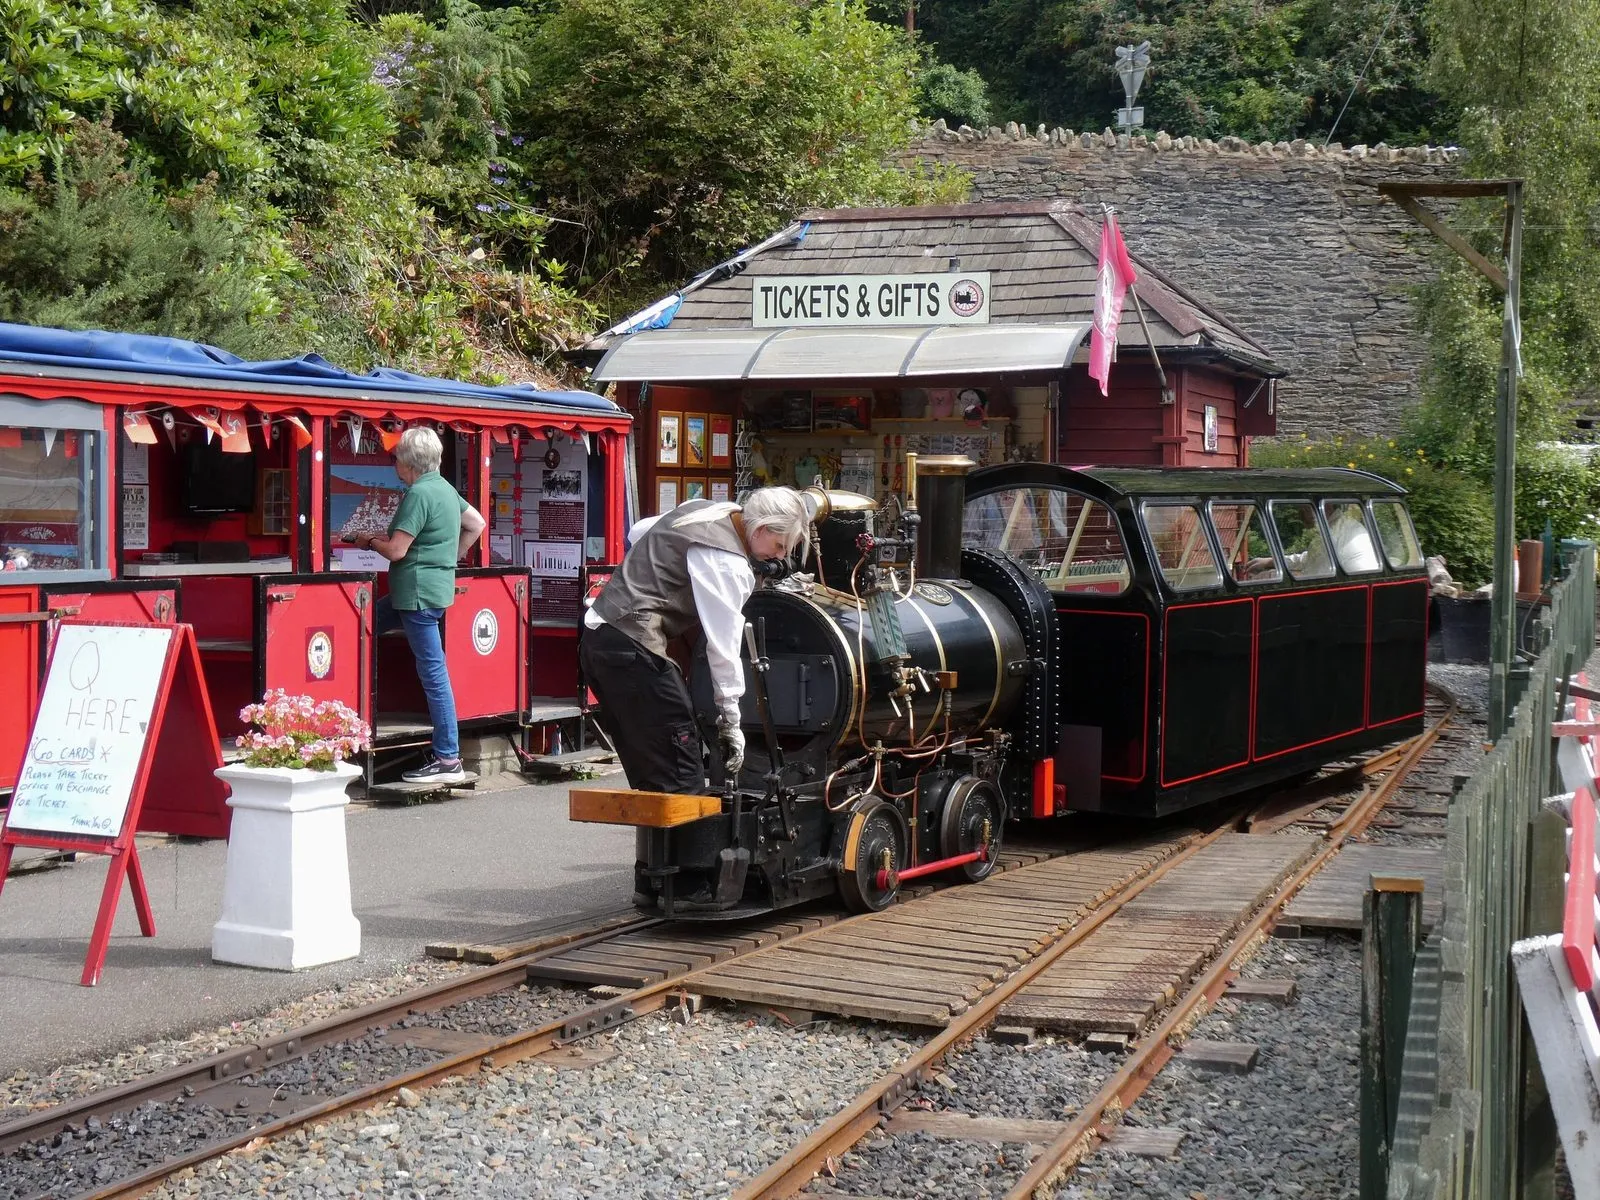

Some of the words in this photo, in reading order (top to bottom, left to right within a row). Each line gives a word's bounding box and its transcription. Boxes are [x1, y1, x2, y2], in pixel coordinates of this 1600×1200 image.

[760, 284, 849, 318] TICKETS
[856, 284, 870, 318] &
[877, 282, 940, 318] GIFTS
[69, 640, 100, 694] Q
[66, 698, 137, 734] HERE
[56, 782, 64, 792] IN
[67, 781, 112, 795] EXCHANGE
